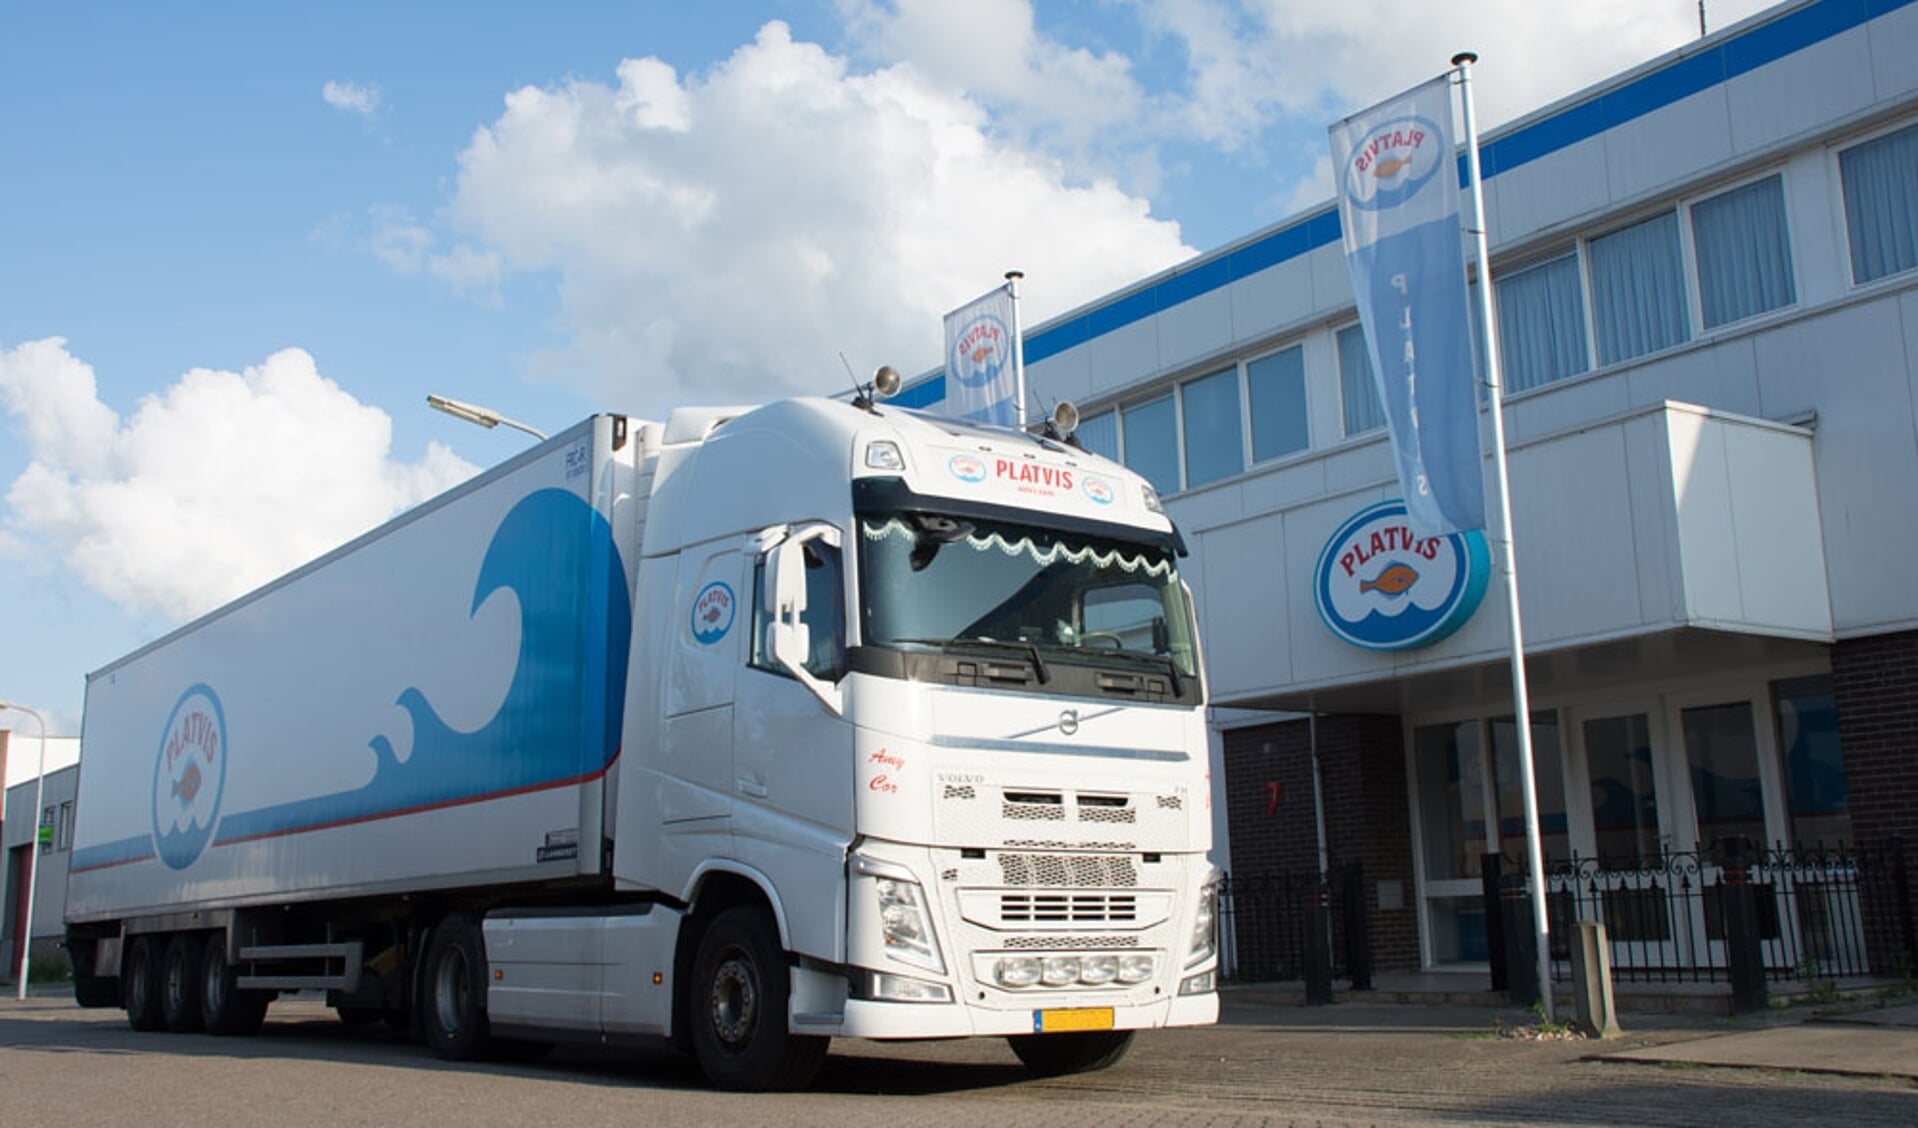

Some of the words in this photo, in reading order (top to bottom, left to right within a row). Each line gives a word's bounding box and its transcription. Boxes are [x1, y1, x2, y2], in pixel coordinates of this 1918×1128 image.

[996, 459, 1073, 490] PLATVIS
[1340, 526, 1441, 577] PLATVIS
[167, 711, 217, 772] PLATVIS
[868, 748, 905, 770] Amy
[938, 773, 984, 783] VOLVO
[1263, 781, 1282, 816] 7
